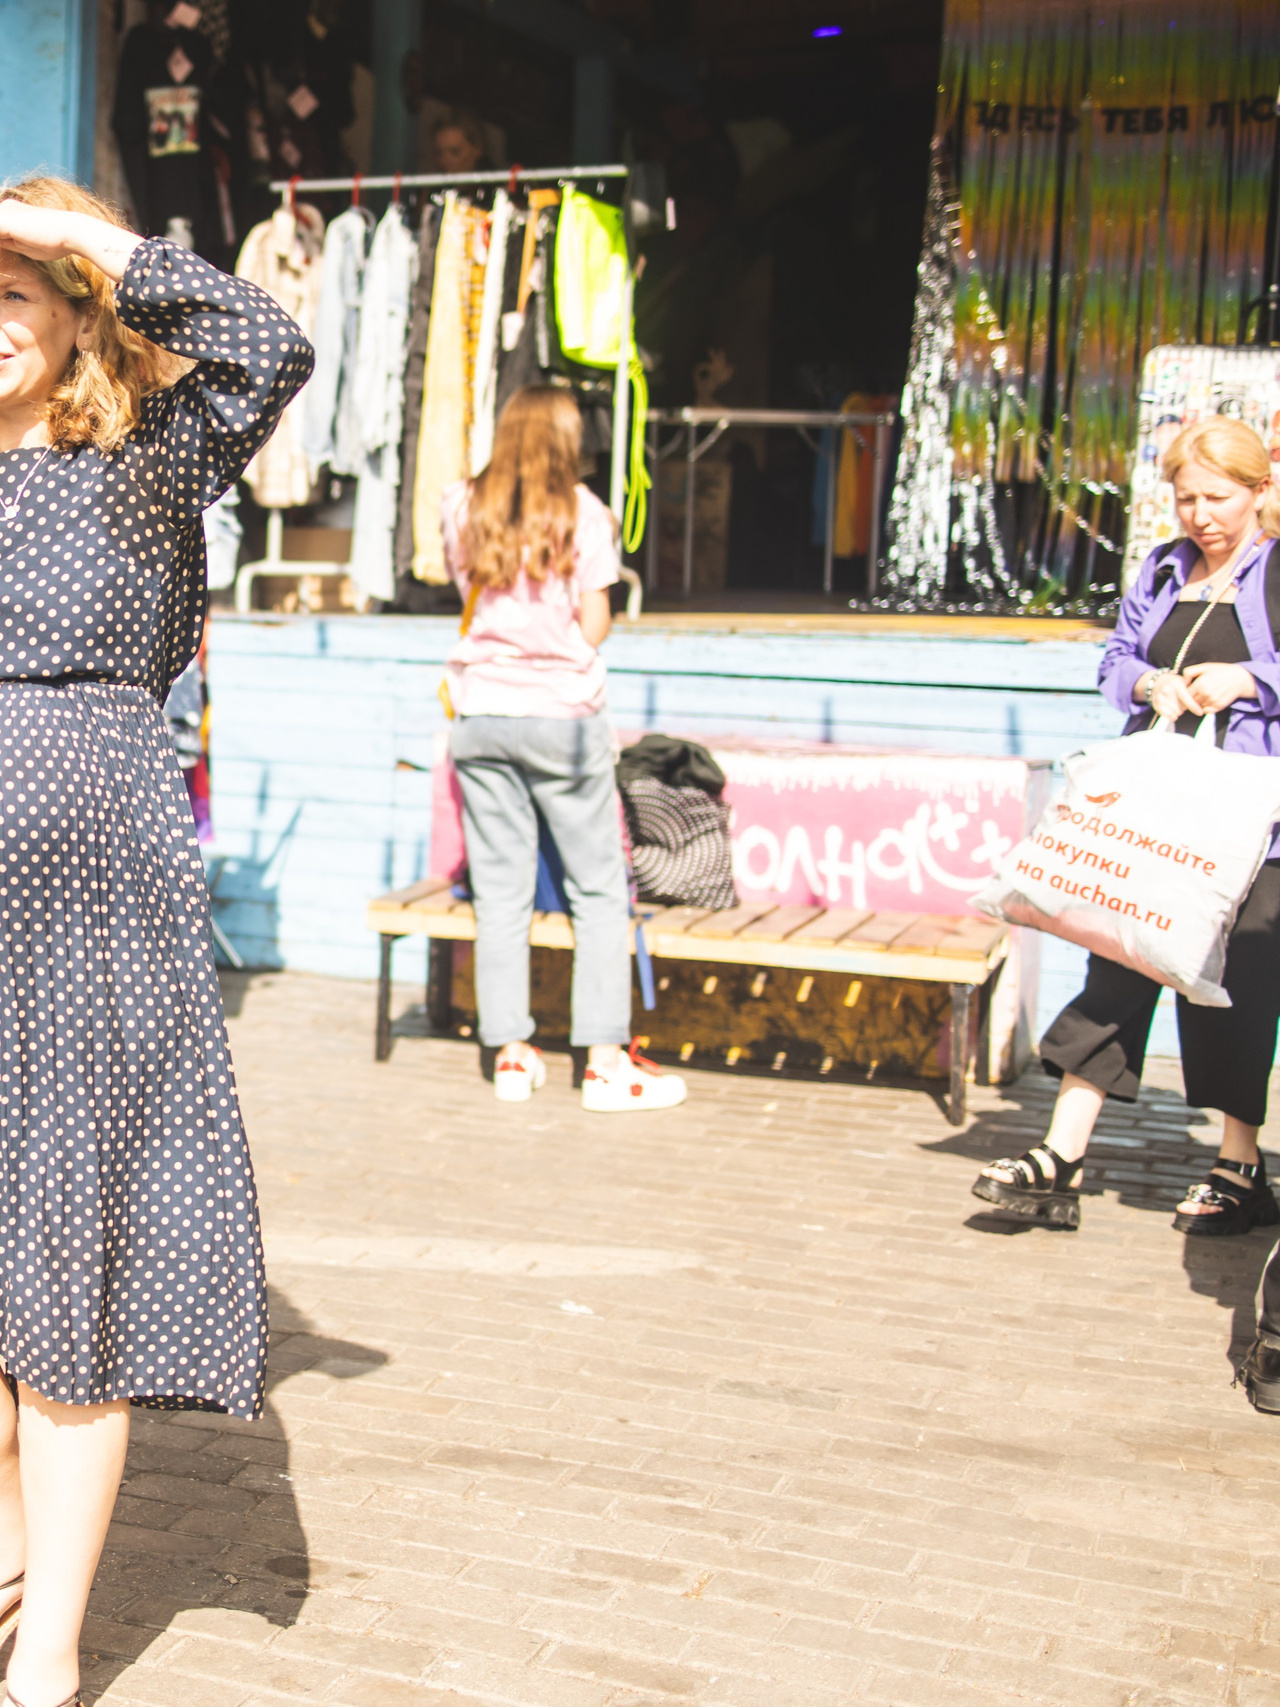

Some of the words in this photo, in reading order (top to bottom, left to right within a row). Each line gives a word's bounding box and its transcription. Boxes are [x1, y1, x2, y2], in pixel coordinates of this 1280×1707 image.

[1101, 106, 1188, 134] ТЕБЯ
[1056, 804, 1217, 876] родолжайте
[1016, 859, 1045, 881] на
[1049, 874, 1172, 931] auchan.ru
